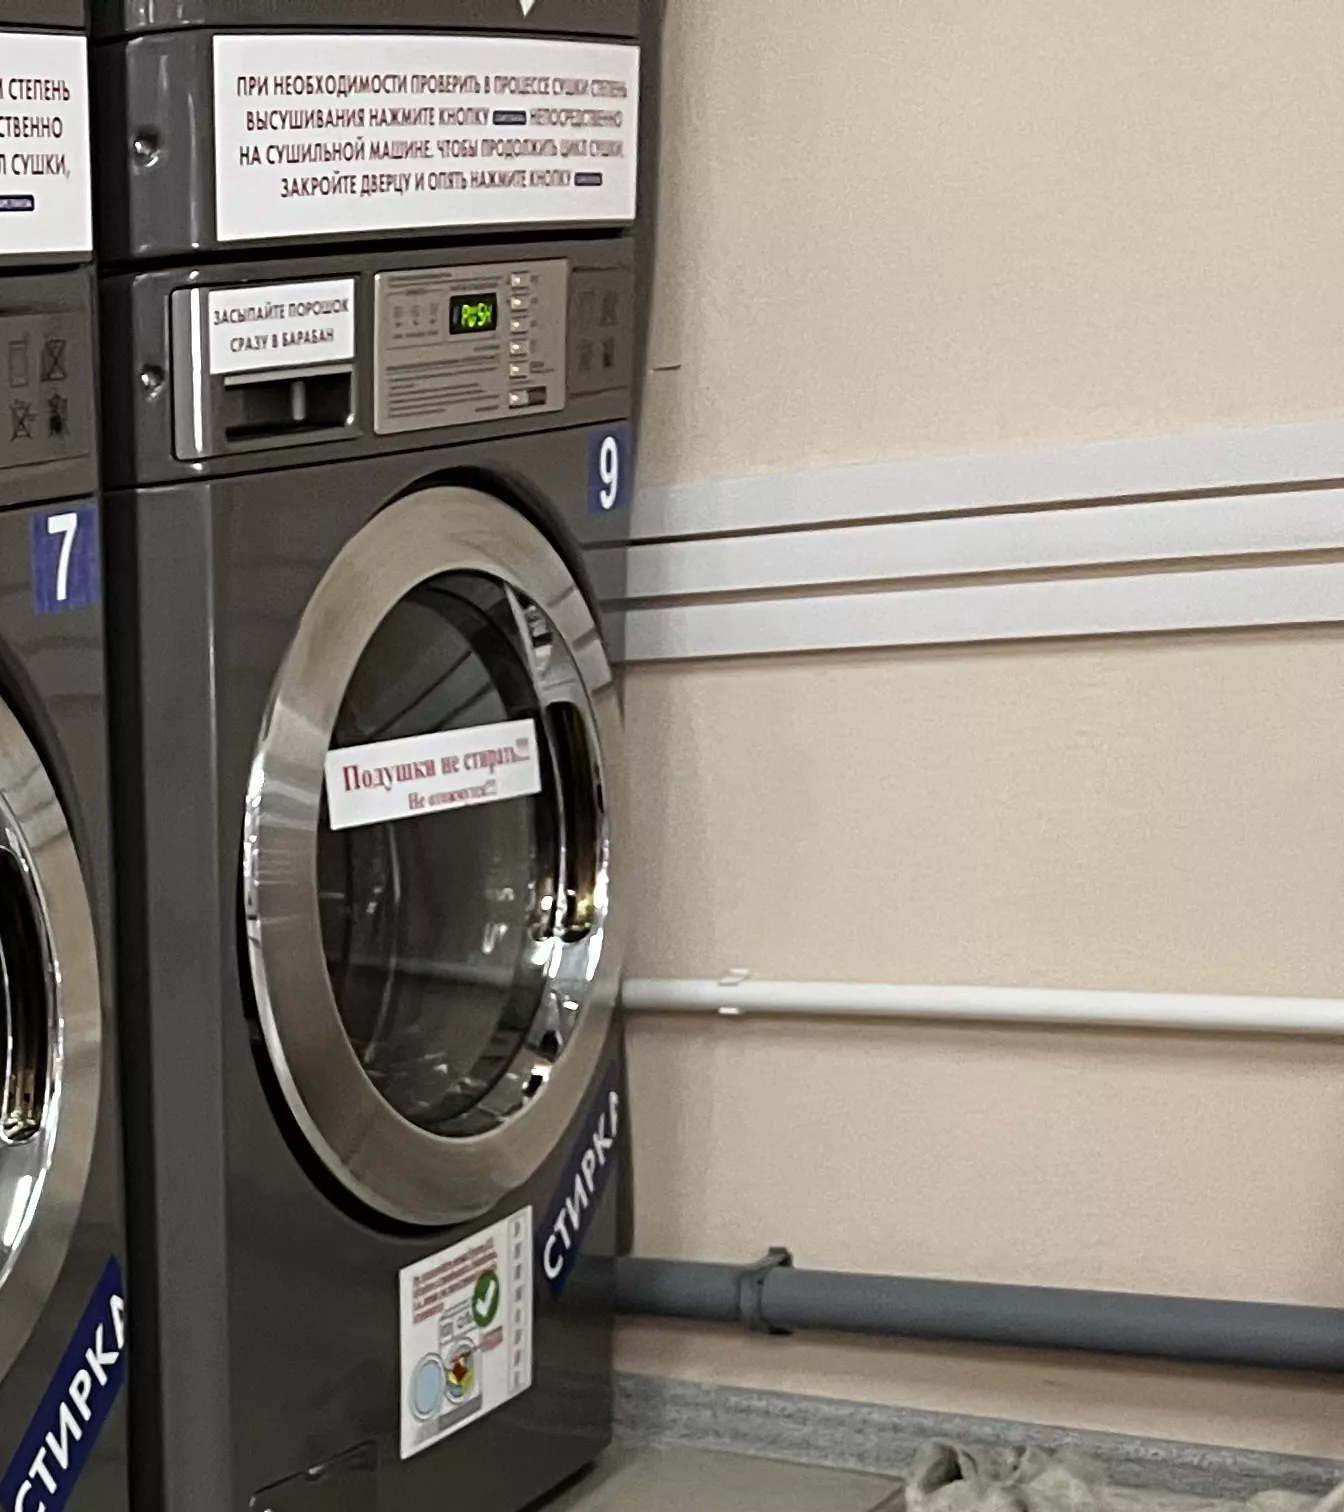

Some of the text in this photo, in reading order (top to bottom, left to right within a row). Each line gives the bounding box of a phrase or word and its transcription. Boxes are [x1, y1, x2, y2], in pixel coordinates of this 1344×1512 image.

[8, 77, 71, 102] СТЕПЕНЬ
[237, 76, 268, 96] ПРИ
[274, 75, 407, 97] НЕОБХОДИМОСТИ
[246, 109, 365, 131] ВЫСУШИВАНИЯ
[369, 107, 435, 126] НАЖМИТЕ
[240, 146, 261, 165] НА
[266, 136, 365, 164] СУШИЛЬНОЙ
[11, 153, 71, 179] СУШКИ,
[280, 170, 357, 198] ЗАКРОЙТЕ
[361, 173, 412, 196] ДВЕРЦУ
[213, 302, 286, 326] ЗАСЫПАЙТЕ
[599, 435, 618, 511] 9
[47, 511, 78, 601] 7
[342, 759, 436, 792] Подушки
